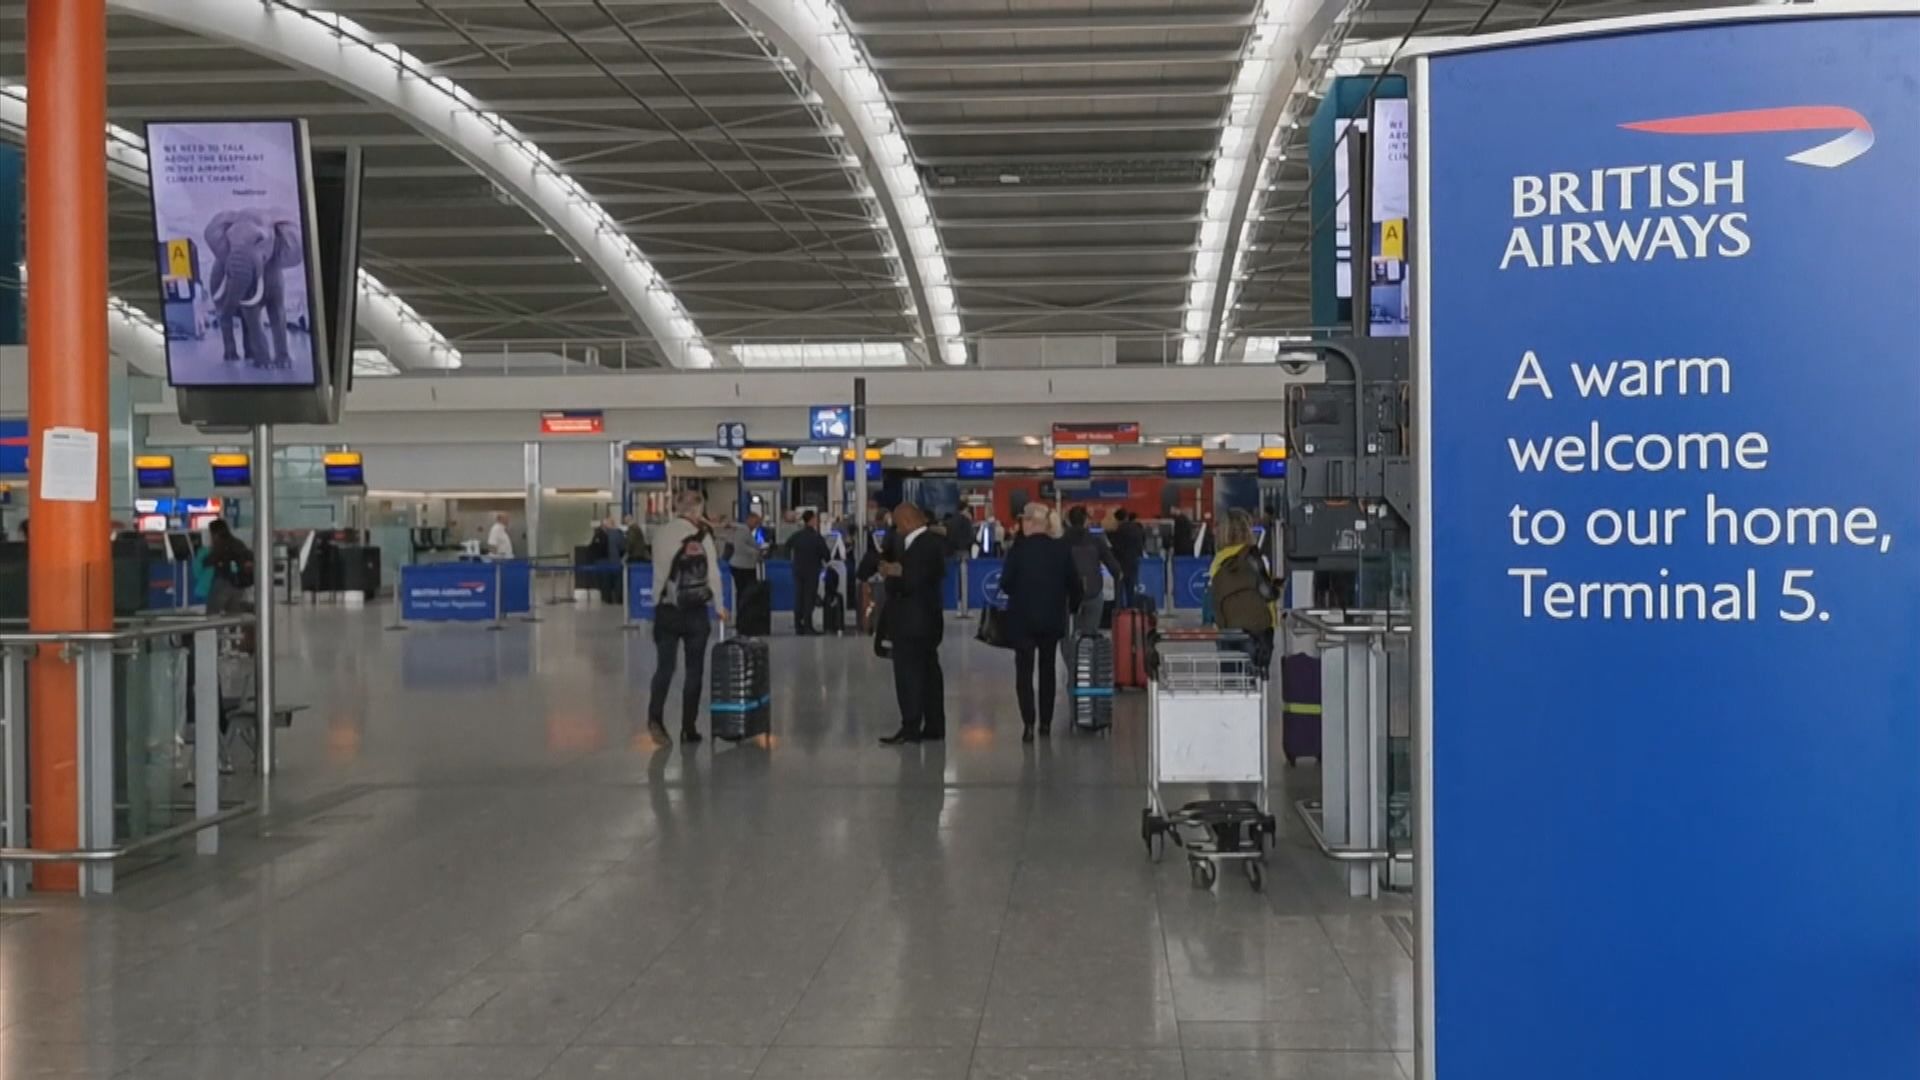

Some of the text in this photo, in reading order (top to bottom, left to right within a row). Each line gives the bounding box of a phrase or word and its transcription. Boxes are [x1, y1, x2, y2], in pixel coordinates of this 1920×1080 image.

[164, 153, 264, 163] ABOUT THE ELEPHANT
[180, 143, 205, 153] NEED
[207, 143, 219, 153] TO
[222, 143, 244, 152] TALK
[166, 175, 204, 184] CLIMATE
[177, 164, 194, 173] THE
[1512, 159, 1744, 218] BRITISH
[1386, 225, 1399, 240] A
[1500, 213, 1751, 269] AIRWAYS
[172, 245, 185, 261] A
[1507, 351, 1731, 400] A warm
[1507, 421, 1769, 472] welcome
[1508, 494, 1891, 553] to our home,
[1508, 568, 1830, 621] Terminal 5.
